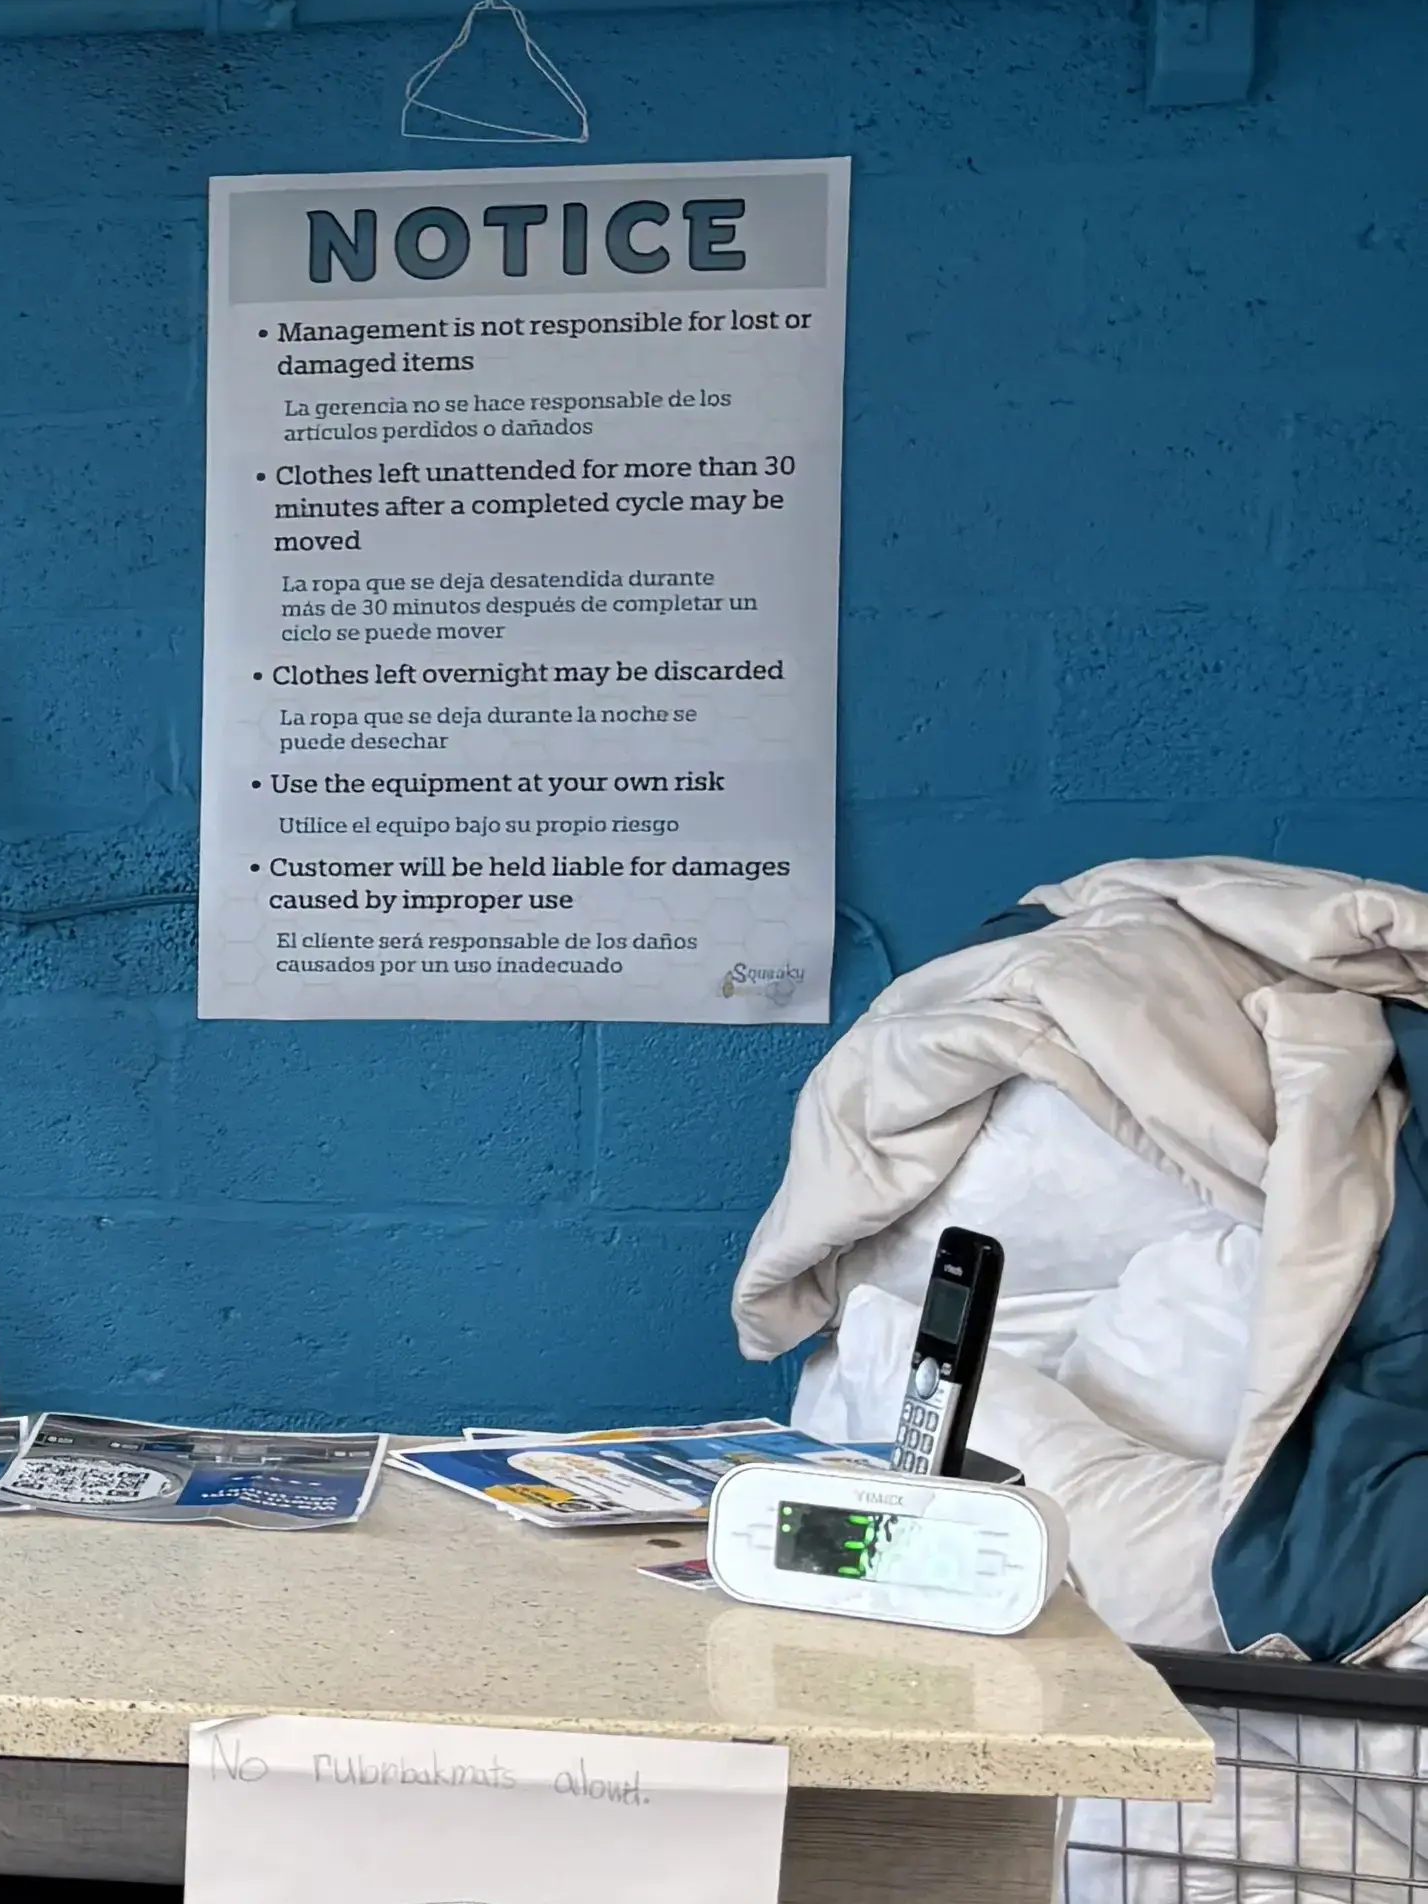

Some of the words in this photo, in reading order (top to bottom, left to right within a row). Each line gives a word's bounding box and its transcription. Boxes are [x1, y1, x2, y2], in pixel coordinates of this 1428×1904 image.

[305, 198, 746, 283] NOTICE
[277, 319, 449, 345] Management
[453, 317, 475, 337] is
[480, 318, 524, 337] not
[530, 311, 683, 339] responsible
[688, 310, 726, 332] for
[730, 309, 779, 330] lost
[785, 313, 812, 329] or
[277, 351, 397, 379] damaged
[402, 351, 474, 373] items
[285, 400, 310, 417] La
[315, 400, 408, 420] gerencia
[413, 400, 441, 414] no
[444, 399, 469, 413] se
[474, 394, 525, 412] hace
[530, 391, 663, 414] responsable
[668, 390, 696, 408] de
[700, 389, 731, 407] los
[382, 419, 478, 444] perdidos
[483, 423, 497, 437] o
[501, 417, 593, 437] dañados
[276, 464, 373, 486] Clothes
[378, 461, 421, 484] left
[425, 458, 577, 482] unattended
[581, 458, 619, 480] for
[623, 461, 692, 479] more
[698, 455, 758, 477] than
[764, 455, 796, 476] 30
[275, 497, 379, 519] minutes
[385, 495, 445, 516] after
[450, 499, 466, 515] a
[471, 491, 610, 519] completed
[615, 490, 684, 517] cycle
[690, 494, 747, 515] may
[752, 488, 784, 510] be
[273, 529, 362, 552] moved
[282, 575, 308, 593] La
[312, 578, 361, 596] ropa
[366, 577, 406, 595] que
[410, 577, 435, 590] se
[439, 572, 485, 594] deja
[490, 569, 623, 589] desatendida
[628, 569, 714, 587] durante
[282, 601, 326, 617] más
[330, 599, 357, 616] de
[362, 598, 388, 616] 30
[392, 599, 481, 616] minutos
[486, 596, 576, 618] después
[581, 595, 607, 613] de
[613, 594, 723, 616] completar
[729, 598, 757, 610] un
[281, 624, 332, 642] ciclo
[336, 628, 360, 641] se
[365, 622, 432, 645] puede
[436, 626, 505, 640] mover
[272, 664, 369, 686] Clothes
[374, 663, 417, 685] left
[422, 661, 549, 688] overnight
[553, 666, 612, 687] may
[615, 660, 648, 682] be
[654, 659, 785, 682] discarded
[270, 774, 318, 794] Use
[324, 772, 365, 794] the
[371, 772, 513, 798] equipment
[517, 774, 543, 793] at
[548, 776, 609, 797] your
[614, 776, 669, 792] own
[674, 770, 725, 792] risk
[279, 816, 348, 834] Utilice
[352, 816, 370, 834] el
[376, 816, 450, 838] equipo
[455, 816, 501, 837] bajo
[505, 820, 531, 833] su
[536, 819, 607, 837] propio
[611, 819, 679, 836] riesgo
[269, 857, 395, 878] Customer
[399, 856, 447, 877] will
[451, 856, 484, 877] be
[488, 855, 547, 877] held
[551, 855, 624, 877] liable
[629, 855, 667, 877] for
[671, 855, 790, 882] damages
[269, 888, 360, 910] caused
[364, 889, 398, 914] by
[402, 889, 524, 914] improper
[528, 894, 574, 910] use
[276, 932, 297, 949] El
[302, 932, 375, 949] cliente
[378, 932, 424, 950] será
[428, 932, 560, 953] responsable
[565, 932, 591, 950] de
[596, 932, 627, 950] los
[632, 932, 697, 950] daños
[276, 956, 375, 973] causados
[379, 960, 417, 977] por
[421, 960, 450, 973] un
[454, 959, 492, 973] uso
[496, 956, 623, 974] inadecuado
[209, 1733, 270, 1783] No
